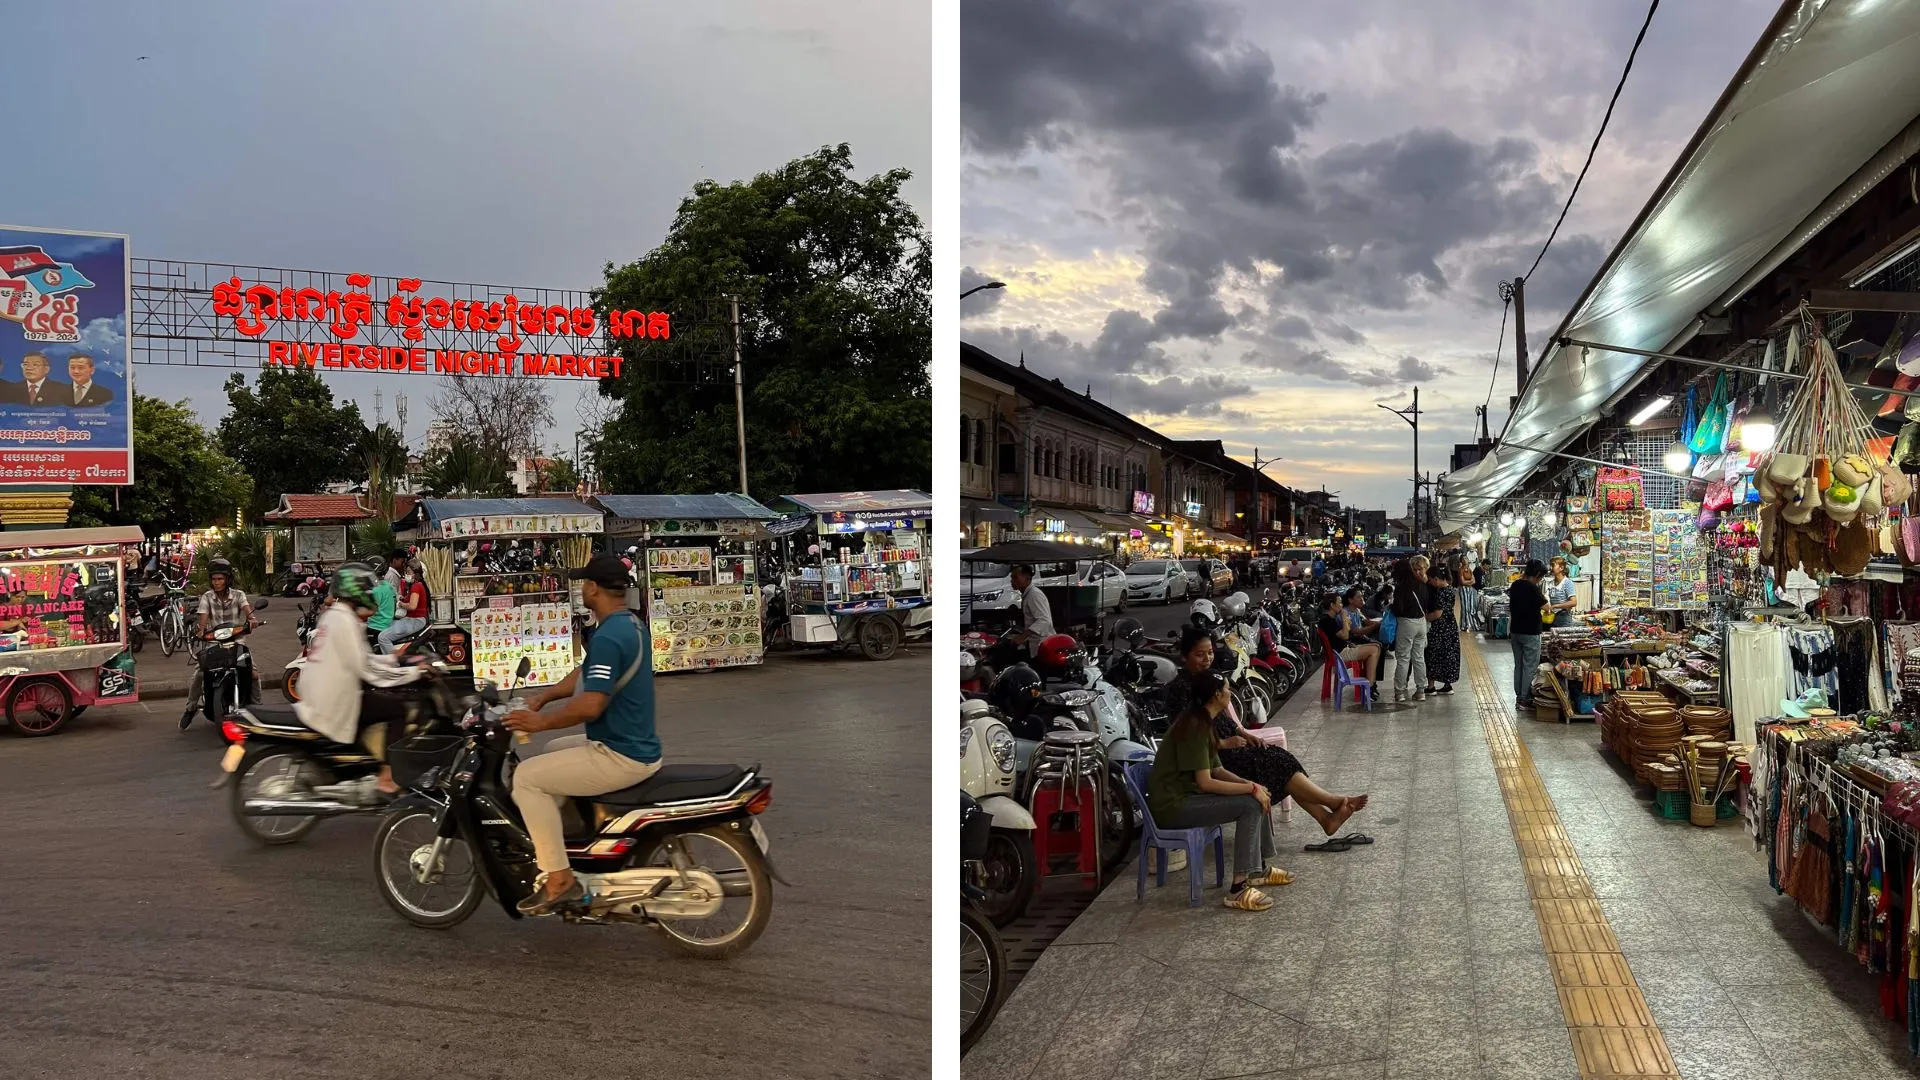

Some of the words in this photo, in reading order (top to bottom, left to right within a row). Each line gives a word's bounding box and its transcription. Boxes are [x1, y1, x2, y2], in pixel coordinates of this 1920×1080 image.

[268, 341, 427, 372] RIVERSIDE
[434, 349, 517, 375] NIGHT
[522, 353, 624, 378] MARKET
[26, 600, 85, 614] PANCAKE
[102, 674, 124, 688] GS
